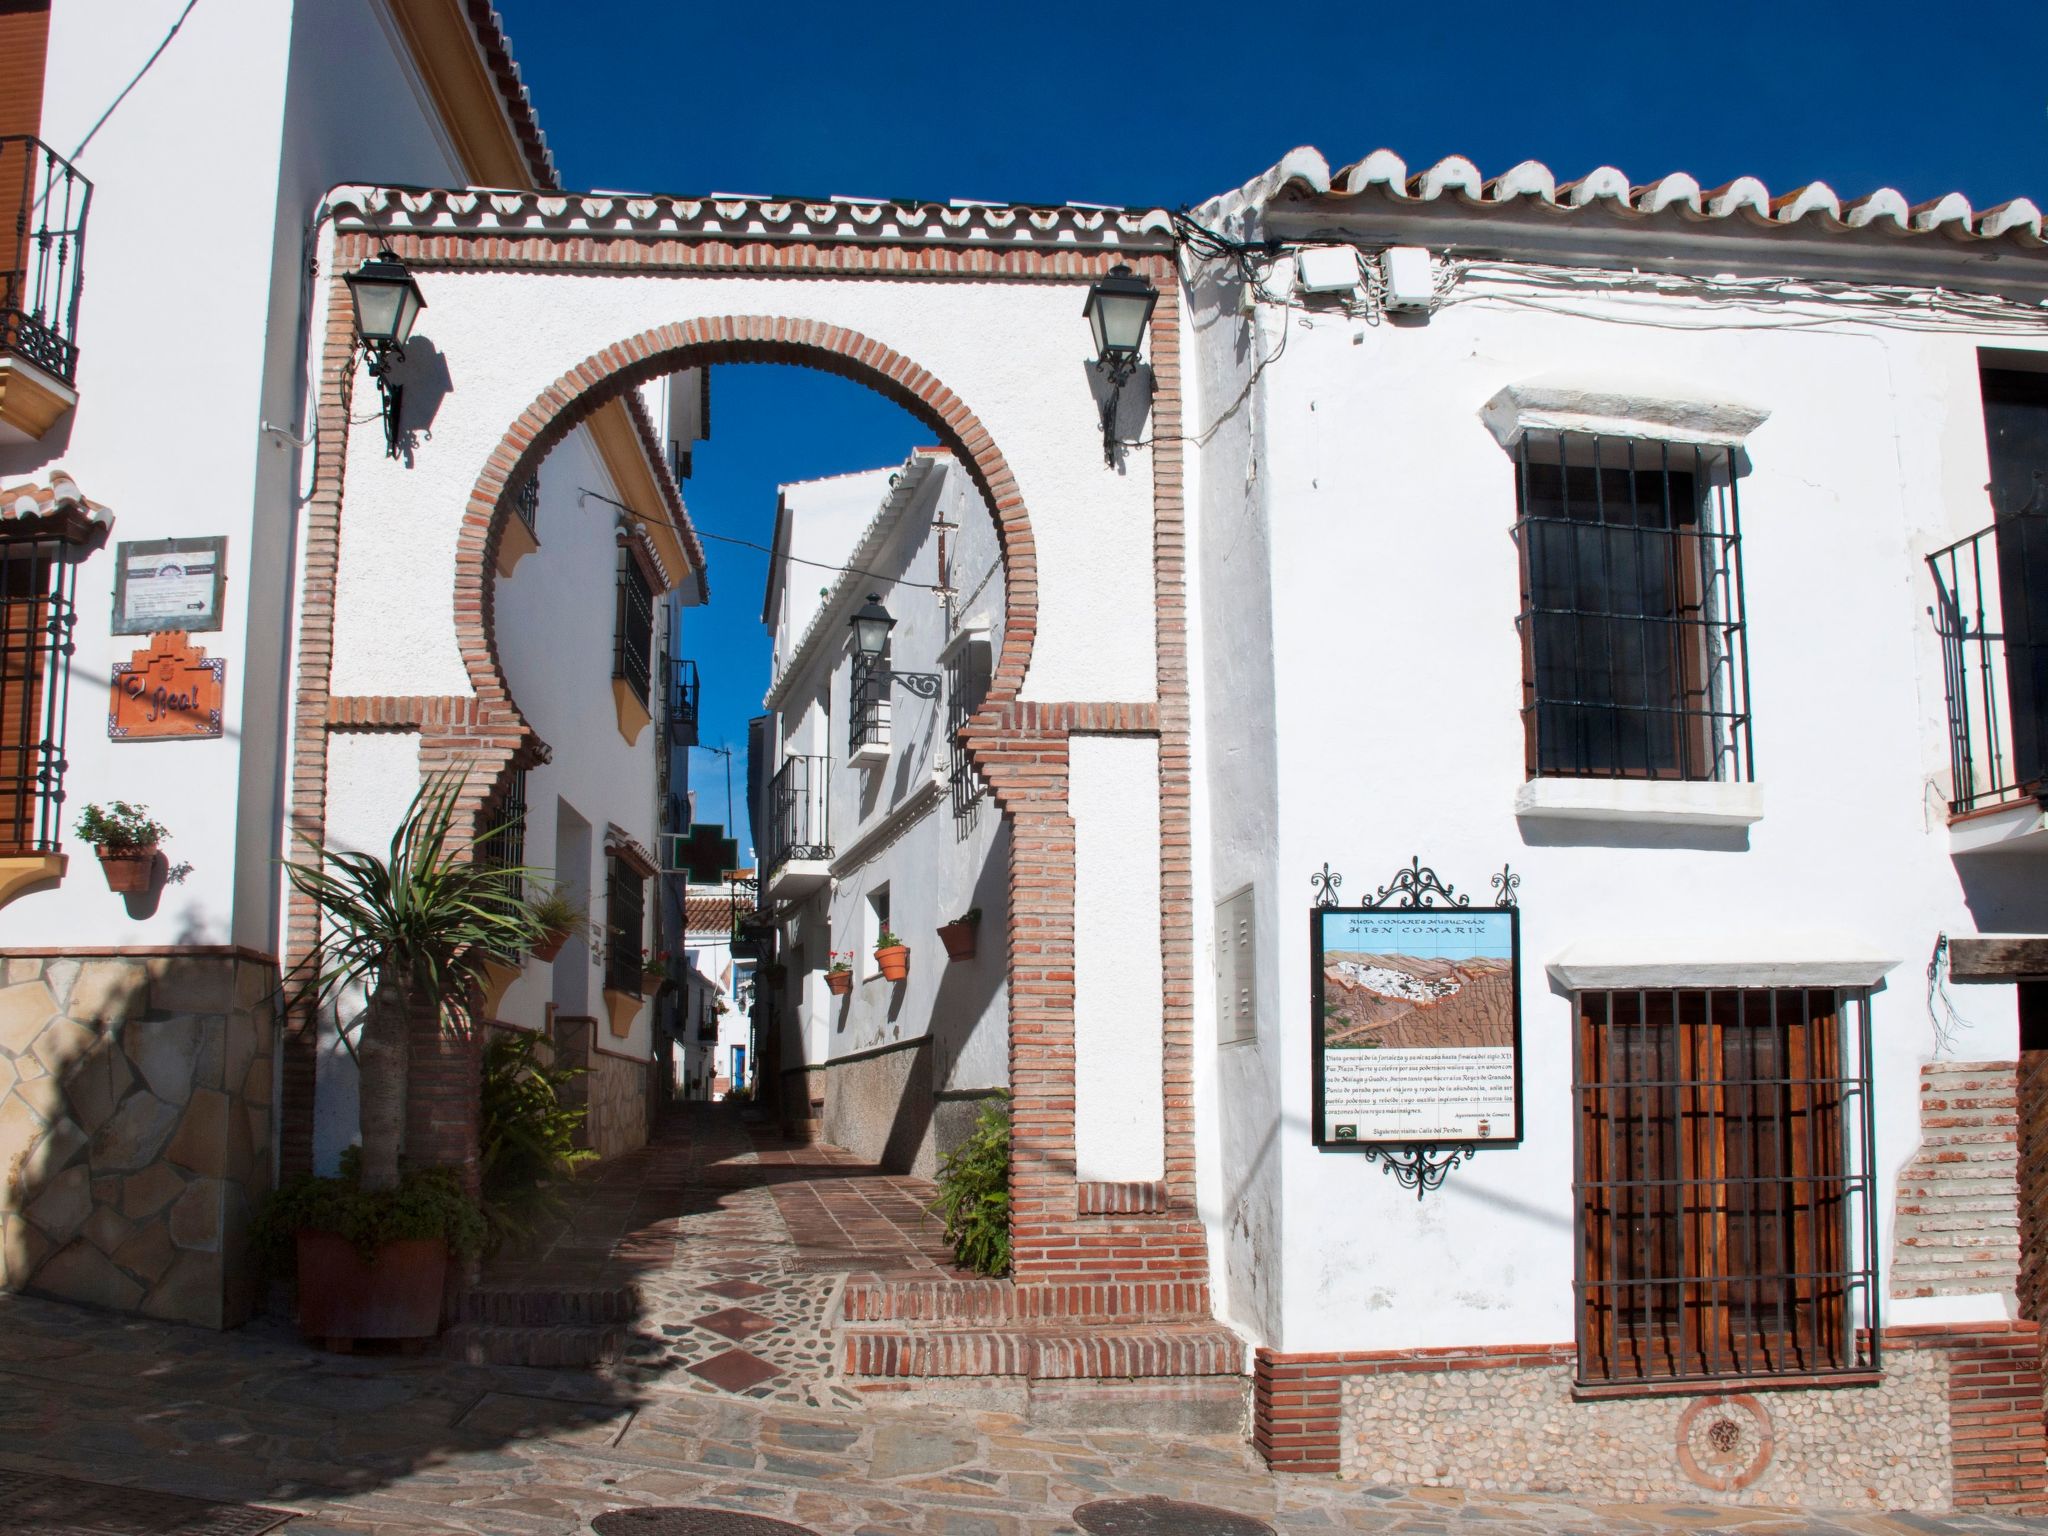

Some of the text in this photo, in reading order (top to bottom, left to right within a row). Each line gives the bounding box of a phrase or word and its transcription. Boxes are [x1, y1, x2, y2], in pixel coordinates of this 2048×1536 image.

[147, 685, 200, 722] Real
[1462, 1074, 1480, 1082] Reyes
[1373, 1128, 1399, 1136] Siguiente
